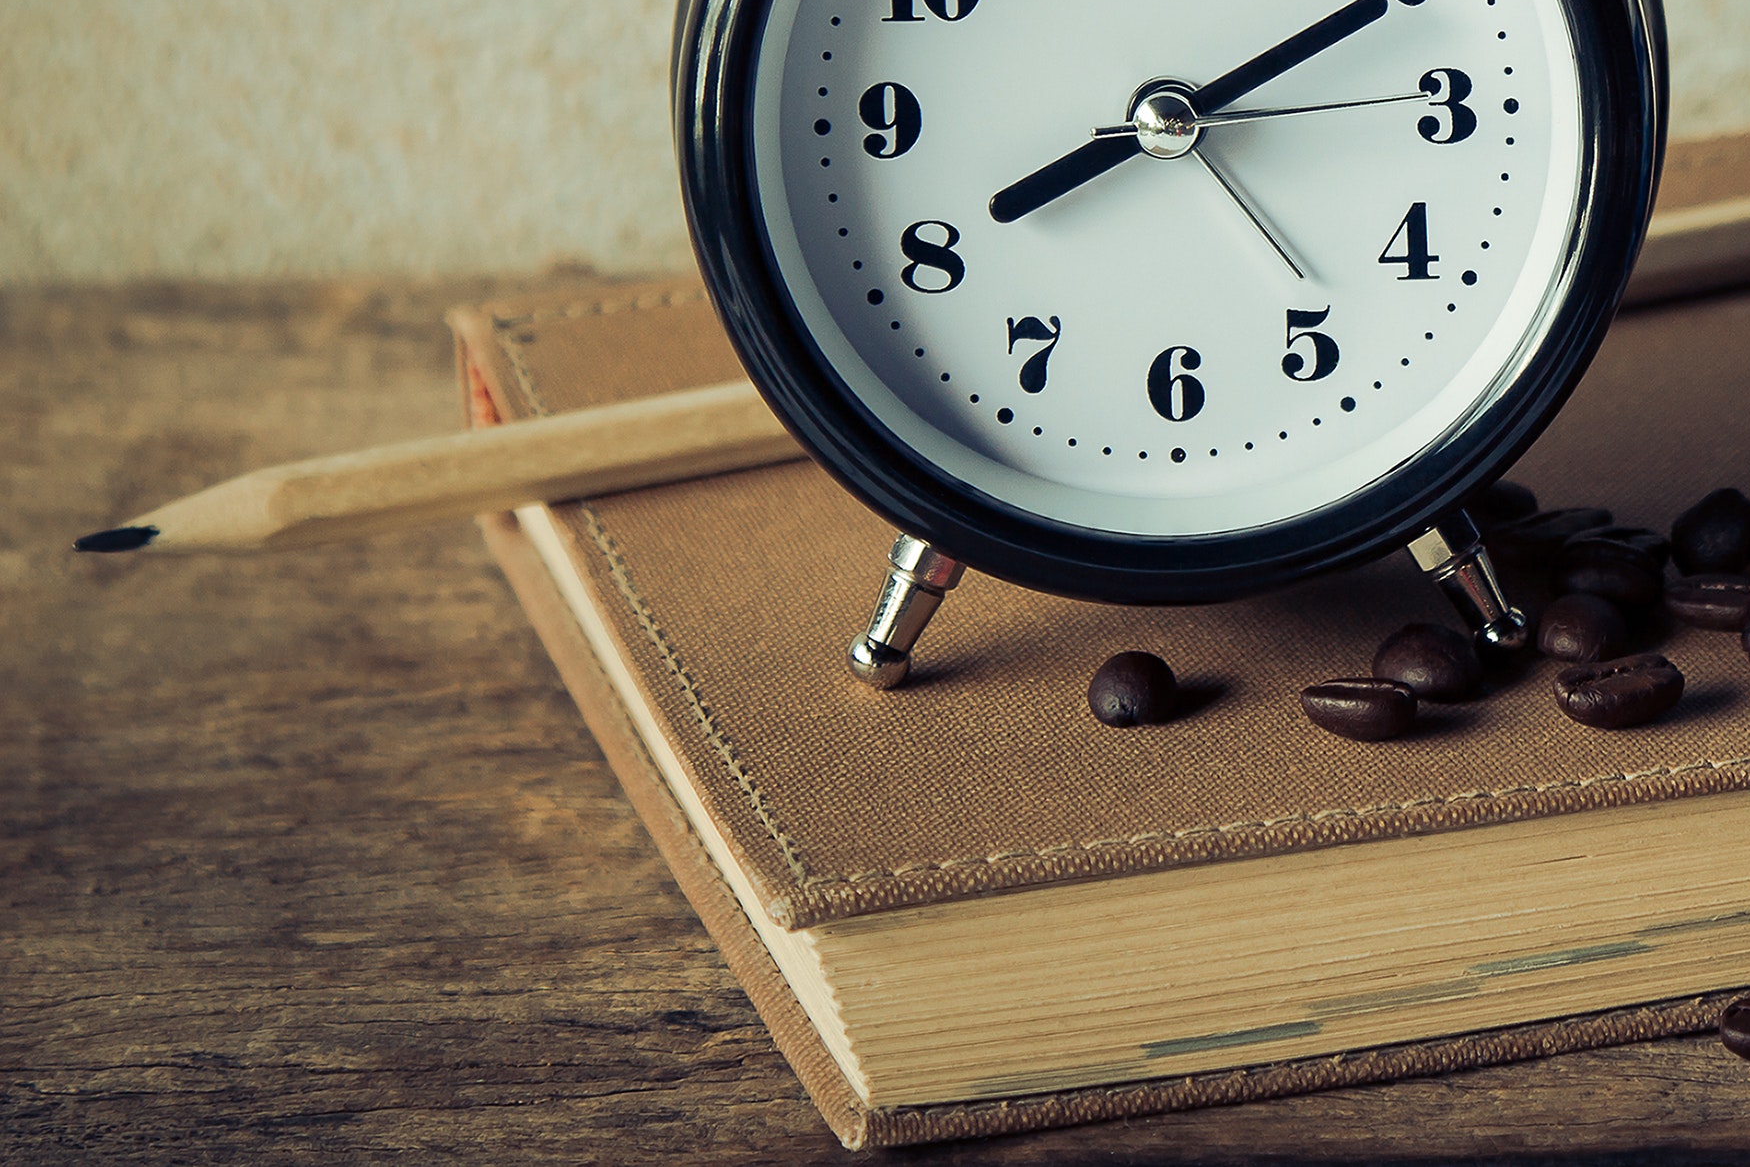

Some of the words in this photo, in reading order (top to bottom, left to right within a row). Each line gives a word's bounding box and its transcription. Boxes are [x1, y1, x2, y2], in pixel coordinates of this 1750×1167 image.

[858, 81, 923, 160] 9
[1417, 67, 1478, 145] 3
[899, 220, 966, 294] 8
[1377, 201, 1441, 281] 4
[1006, 315, 1062, 394] 7
[1281, 304, 1340, 382] 5
[1146, 345, 1206, 423] 6
